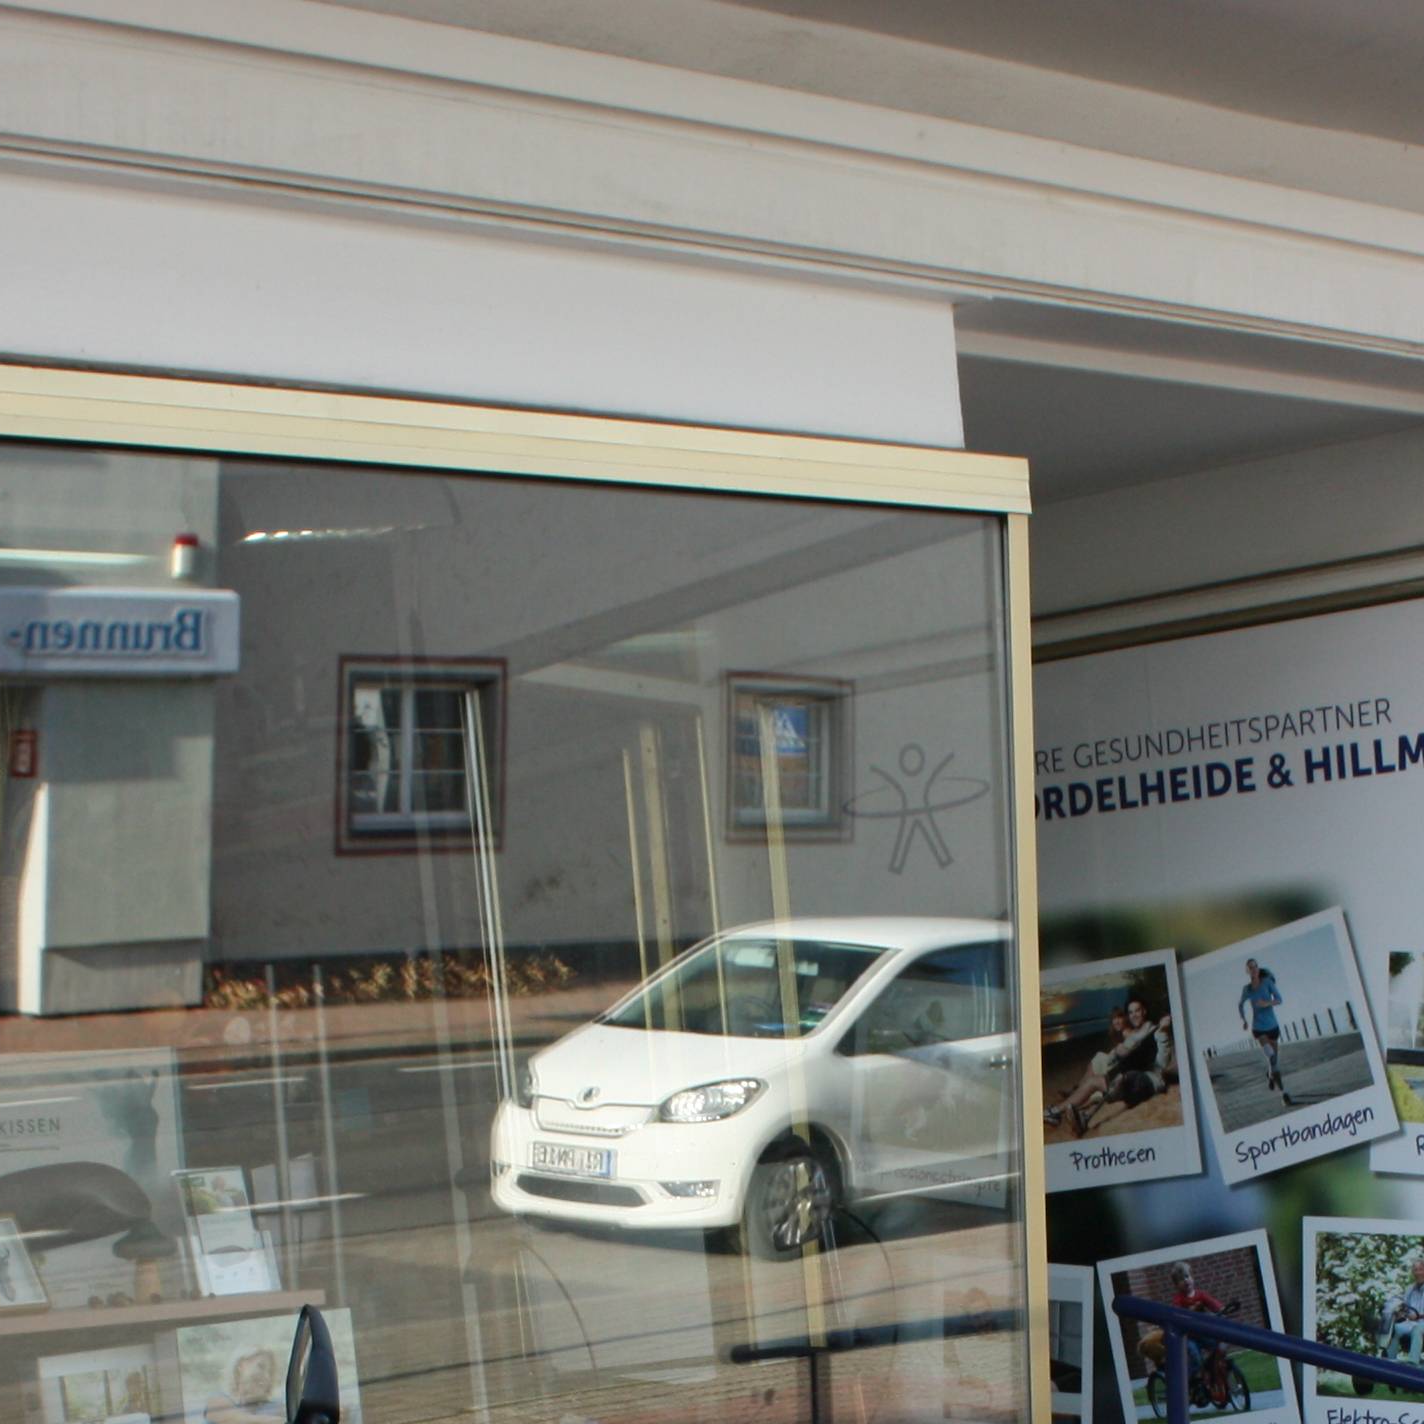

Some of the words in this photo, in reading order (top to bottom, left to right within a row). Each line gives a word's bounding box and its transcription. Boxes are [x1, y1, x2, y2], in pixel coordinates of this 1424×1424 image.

[1034, 747, 1066, 776] RE
[1073, 697, 1393, 769] GESUNDHEITSPARTNER
[1034, 756, 1257, 821] RDELHEIDE
[1266, 752, 1295, 790] &
[1068, 1143, 1157, 1171] Prothesen
[1234, 1104, 1375, 1170] Sportbandagen
